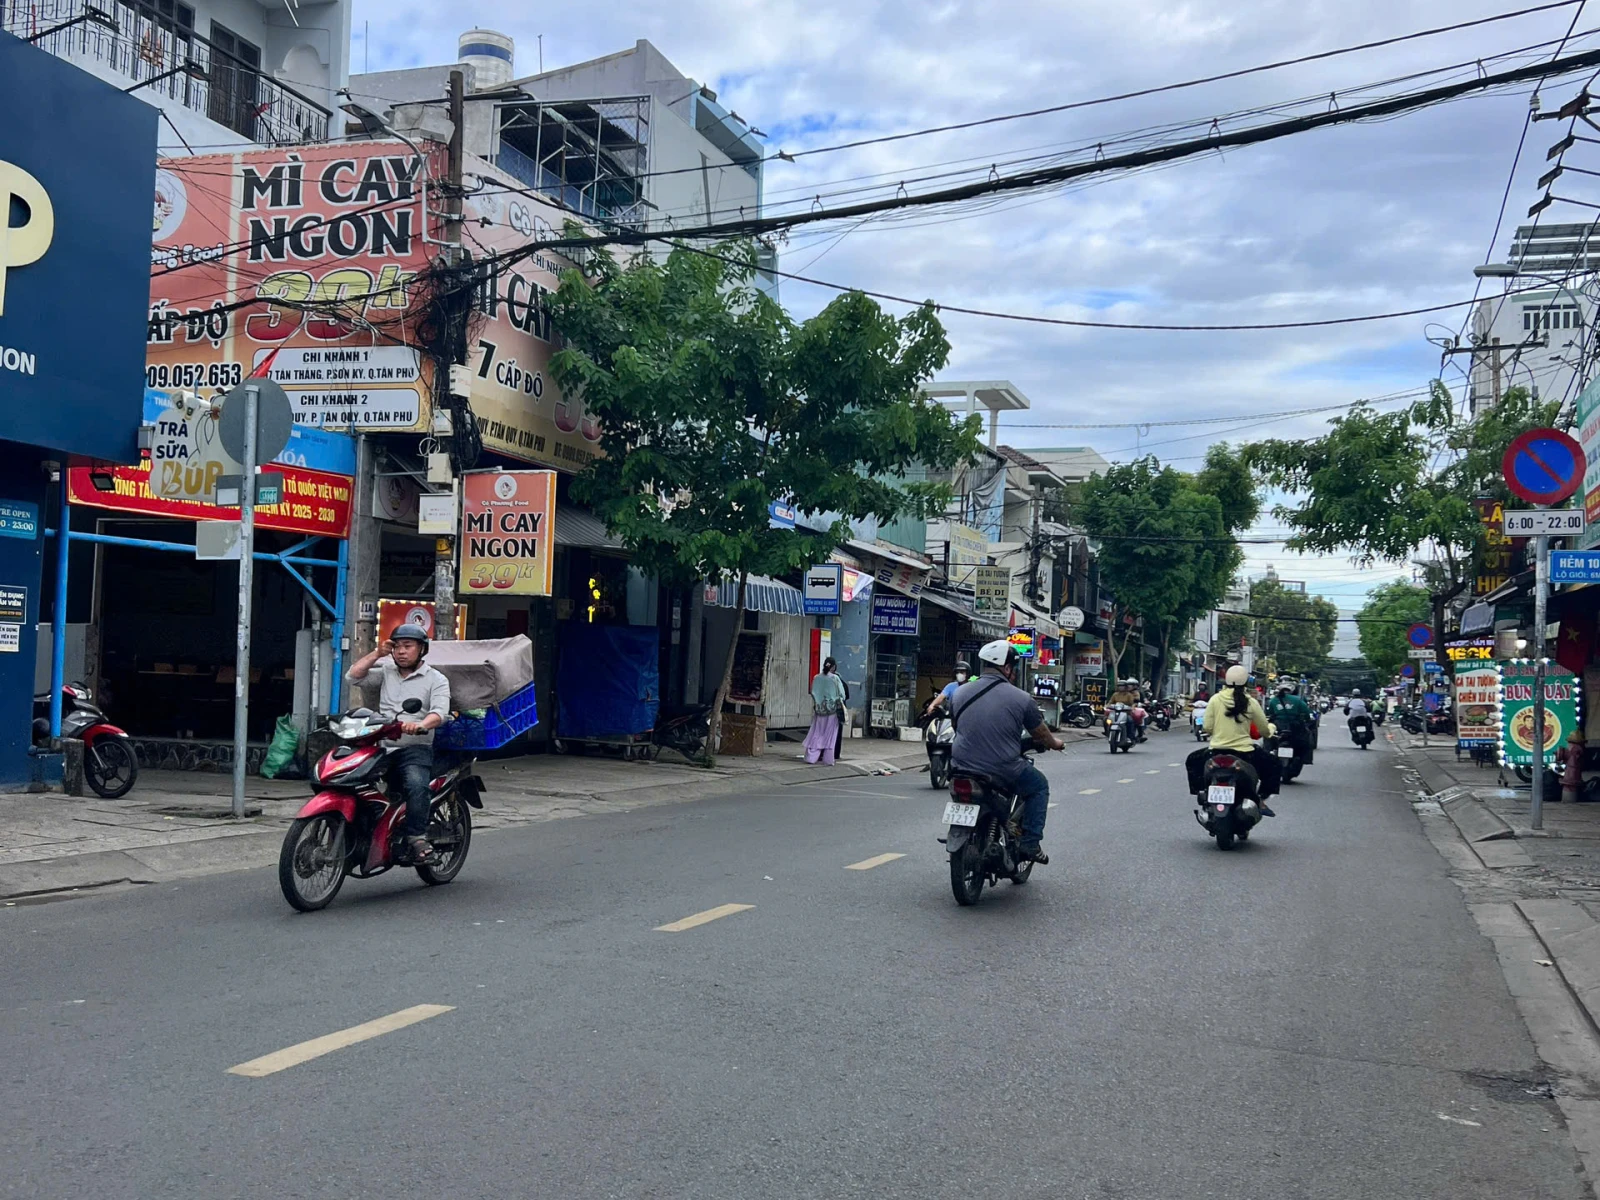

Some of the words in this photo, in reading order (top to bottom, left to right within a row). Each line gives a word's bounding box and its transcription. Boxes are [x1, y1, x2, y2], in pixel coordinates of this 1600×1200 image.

[241, 155, 303, 209] MÌ
[320, 156, 419, 204] CAY
[250, 211, 412, 261] NGON
[303, 353, 320, 362] CHI
[328, 351, 360, 362] NHÁNH
[364, 351, 368, 362] 1
[276, 368, 291, 380] TÂN
[368, 367, 394, 380] Q.TÂN
[396, 366, 414, 378] PHÚ
[478, 339, 497, 379] 7
[497, 360, 521, 391] CẤP
[525, 372, 543, 404] ĐỘ
[301, 396, 318, 406] CHI
[322, 394, 358, 405] NHÁNH
[362, 394, 368, 404] 2
[292, 411, 308, 424] UÝ,
[312, 412, 318, 422] P.
[364, 410, 390, 422] Q.TÂN
[394, 410, 412, 422] PHÚ
[158, 420, 188, 438] TRÀ
[156, 442, 188, 459] SỮA
[288, 475, 296, 494] TỔ
[298, 478, 318, 497] QUỐC
[318, 482, 332, 502] VIỆT
[12, 510, 31, 518] OPEN
[280, 500, 290, 516] KỲ
[292, 504, 312, 520] 2025
[318, 507, 336, 522] 2030
[12, 522, 34, 531] 23:00
[466, 509, 492, 533] MÌ
[500, 512, 542, 533] CAY
[1508, 517, 1534, 530] 6:00
[1548, 516, 1581, 528] 22:00
[470, 538, 536, 558] NGON
[1560, 554, 1584, 568] HẺM
[1556, 570, 1567, 578] LỘ
[1569, 570, 1588, 578] GIỚI:
[1466, 676, 1476, 687] TAI
[1505, 680, 1532, 700] BÚN
[1544, 680, 1572, 705] UẬY
